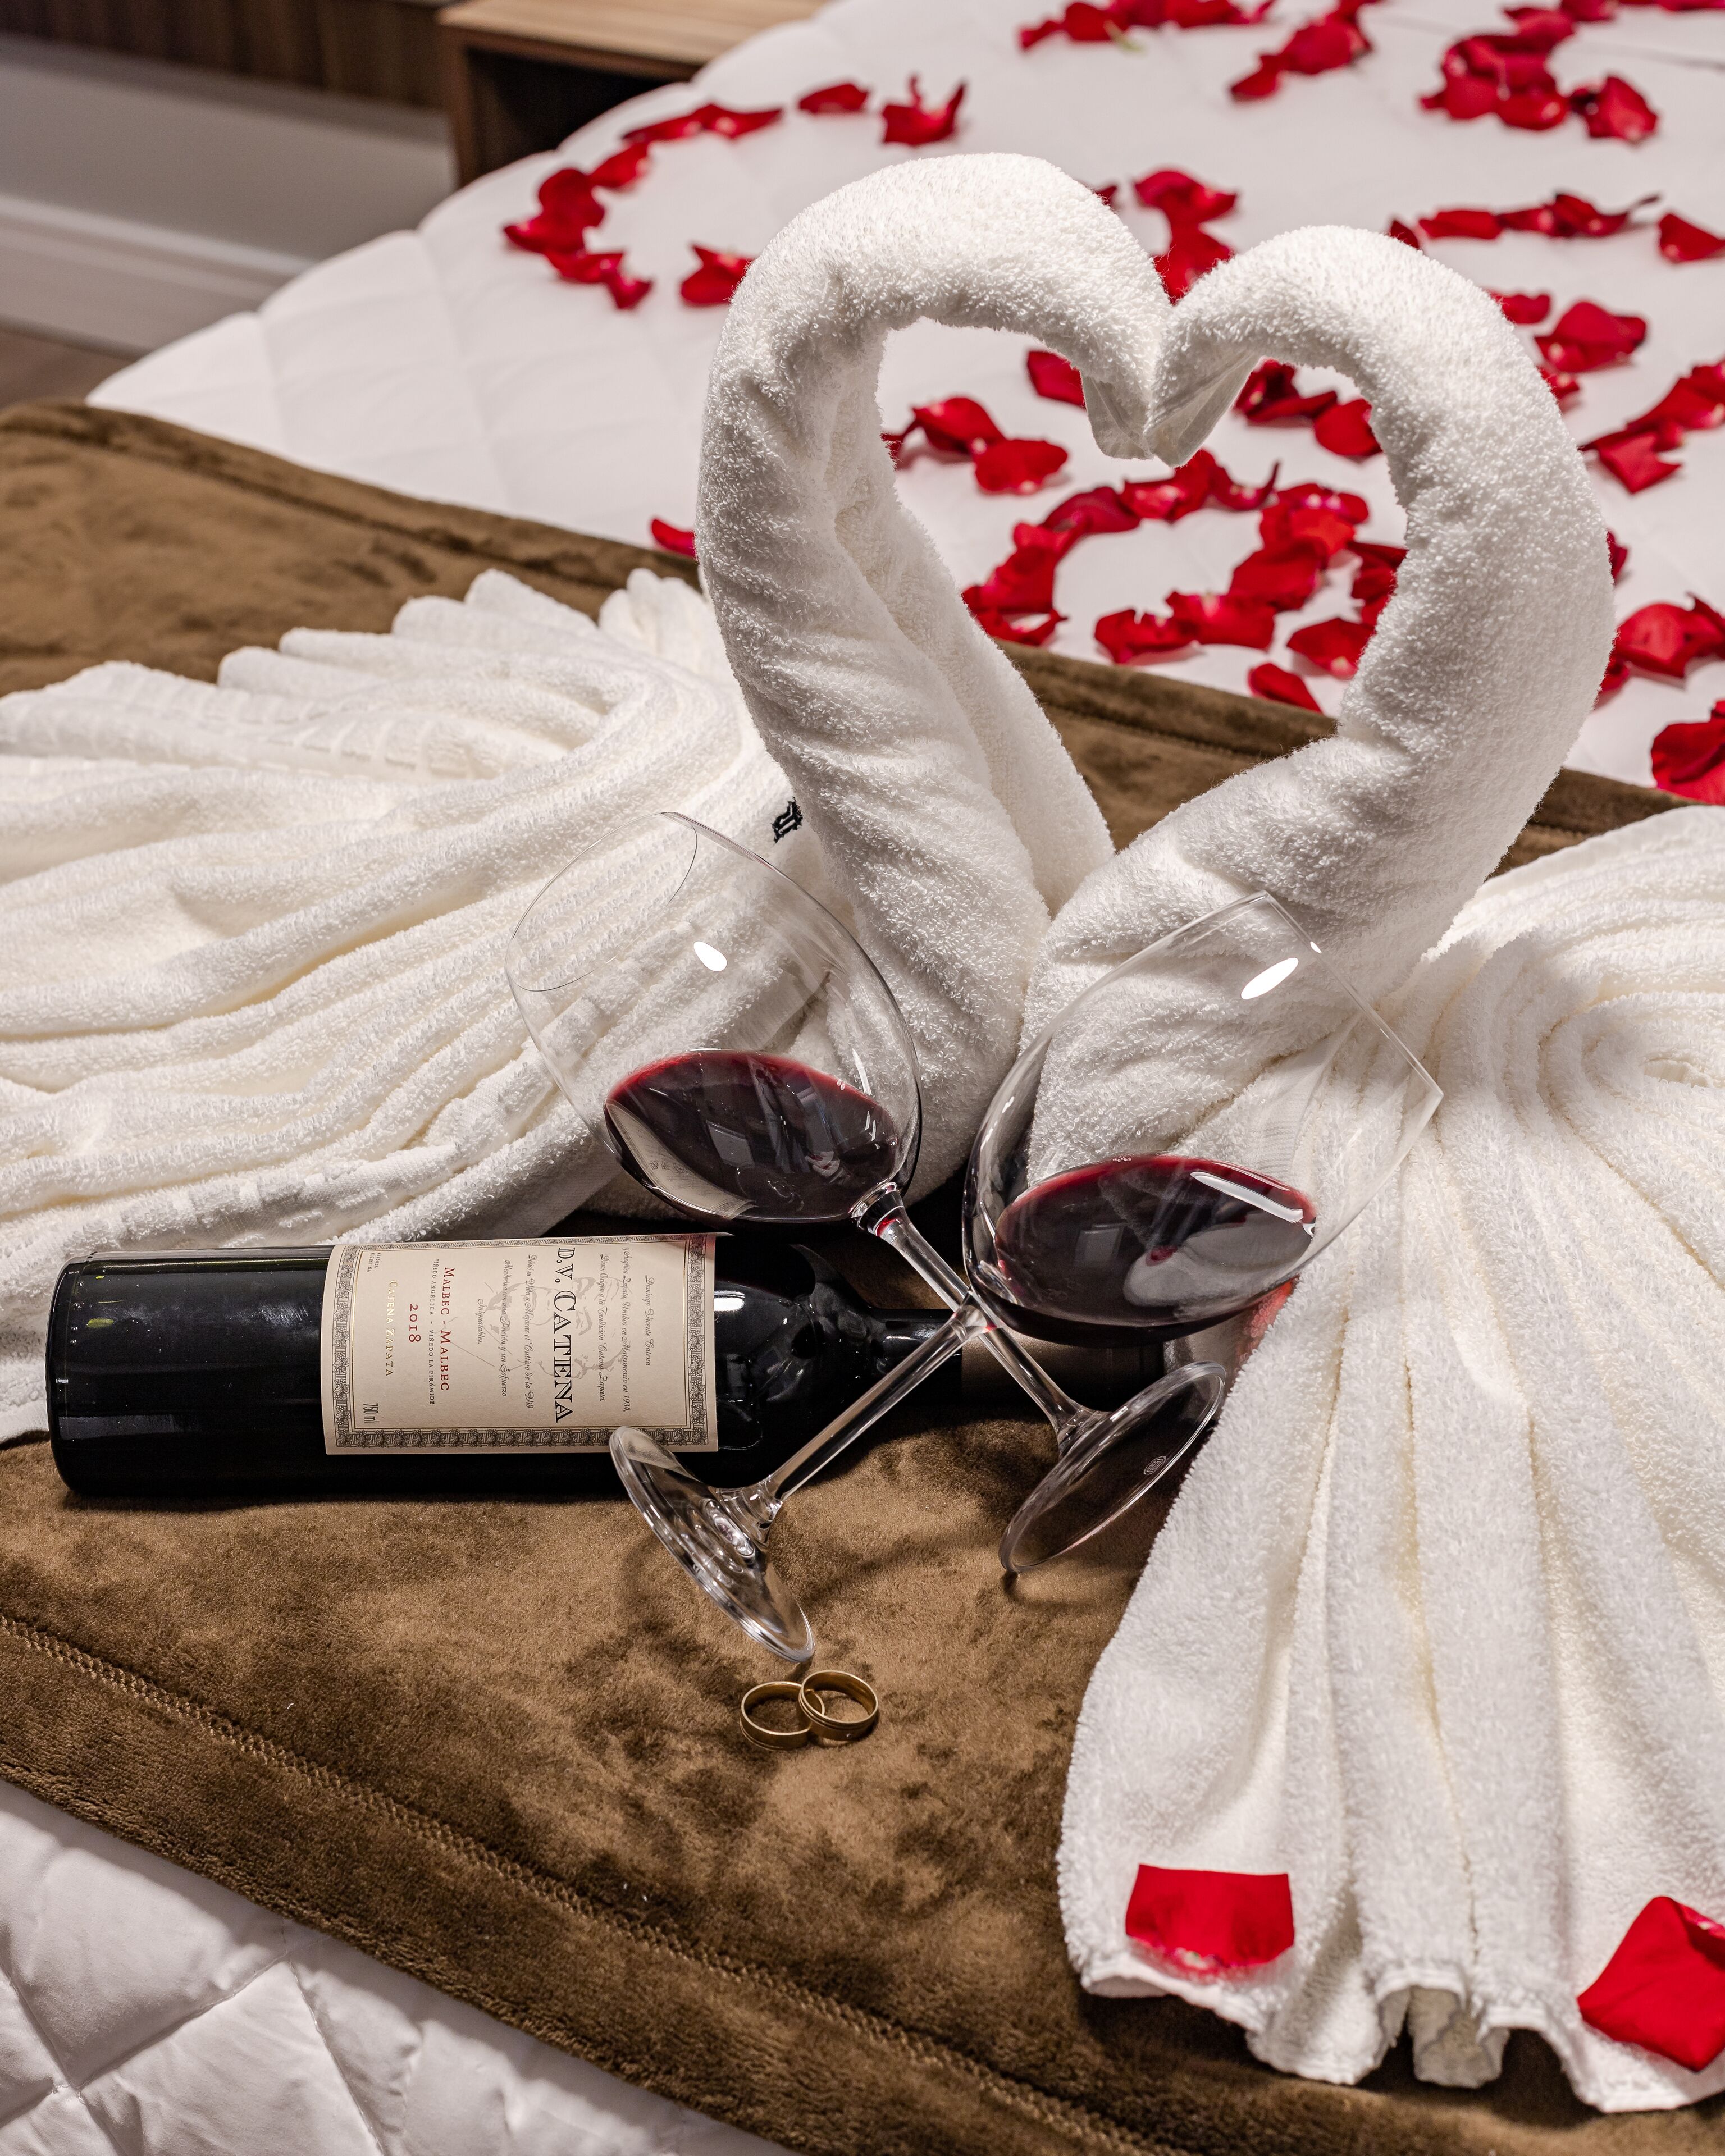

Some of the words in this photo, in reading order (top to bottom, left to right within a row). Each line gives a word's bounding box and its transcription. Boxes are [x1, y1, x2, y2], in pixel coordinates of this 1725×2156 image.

[366, 1252, 375, 1273] ARGENTINA
[502, 1260, 513, 1291] Mendocina
[555, 1248, 575, 1283] D.V.
[599, 1254, 610, 1272] Dieron
[620, 1251, 632, 1275] Angélica
[525, 1278, 535, 1296] Vida
[596, 1273, 608, 1293] Origen
[620, 1276, 631, 1300] Zapata,
[642, 1275, 654, 1307] Domingo
[408, 1304, 421, 1343] 2018
[474, 1299, 487, 1345] Inigualables.
[522, 1302, 534, 1334] Mejorar
[597, 1307, 608, 1341] Tradición
[622, 1301, 631, 1326] Unidos
[644, 1309, 654, 1337] Vicente
[499, 1316, 510, 1345] Pasión
[428, 1360, 433, 1368] LA
[500, 1353, 505, 1363] un
[523, 1342, 533, 1371] Cultivo
[597, 1343, 607, 1371] Catena
[621, 1336, 630, 1383] Matrimonio
[645, 1339, 654, 1367] Catena
[498, 1364, 510, 1397] Esfuerzo
[596, 1372, 608, 1403] Zapata.
[363, 1403, 378, 1414] 750
[524, 1391, 534, 1409] Vid
